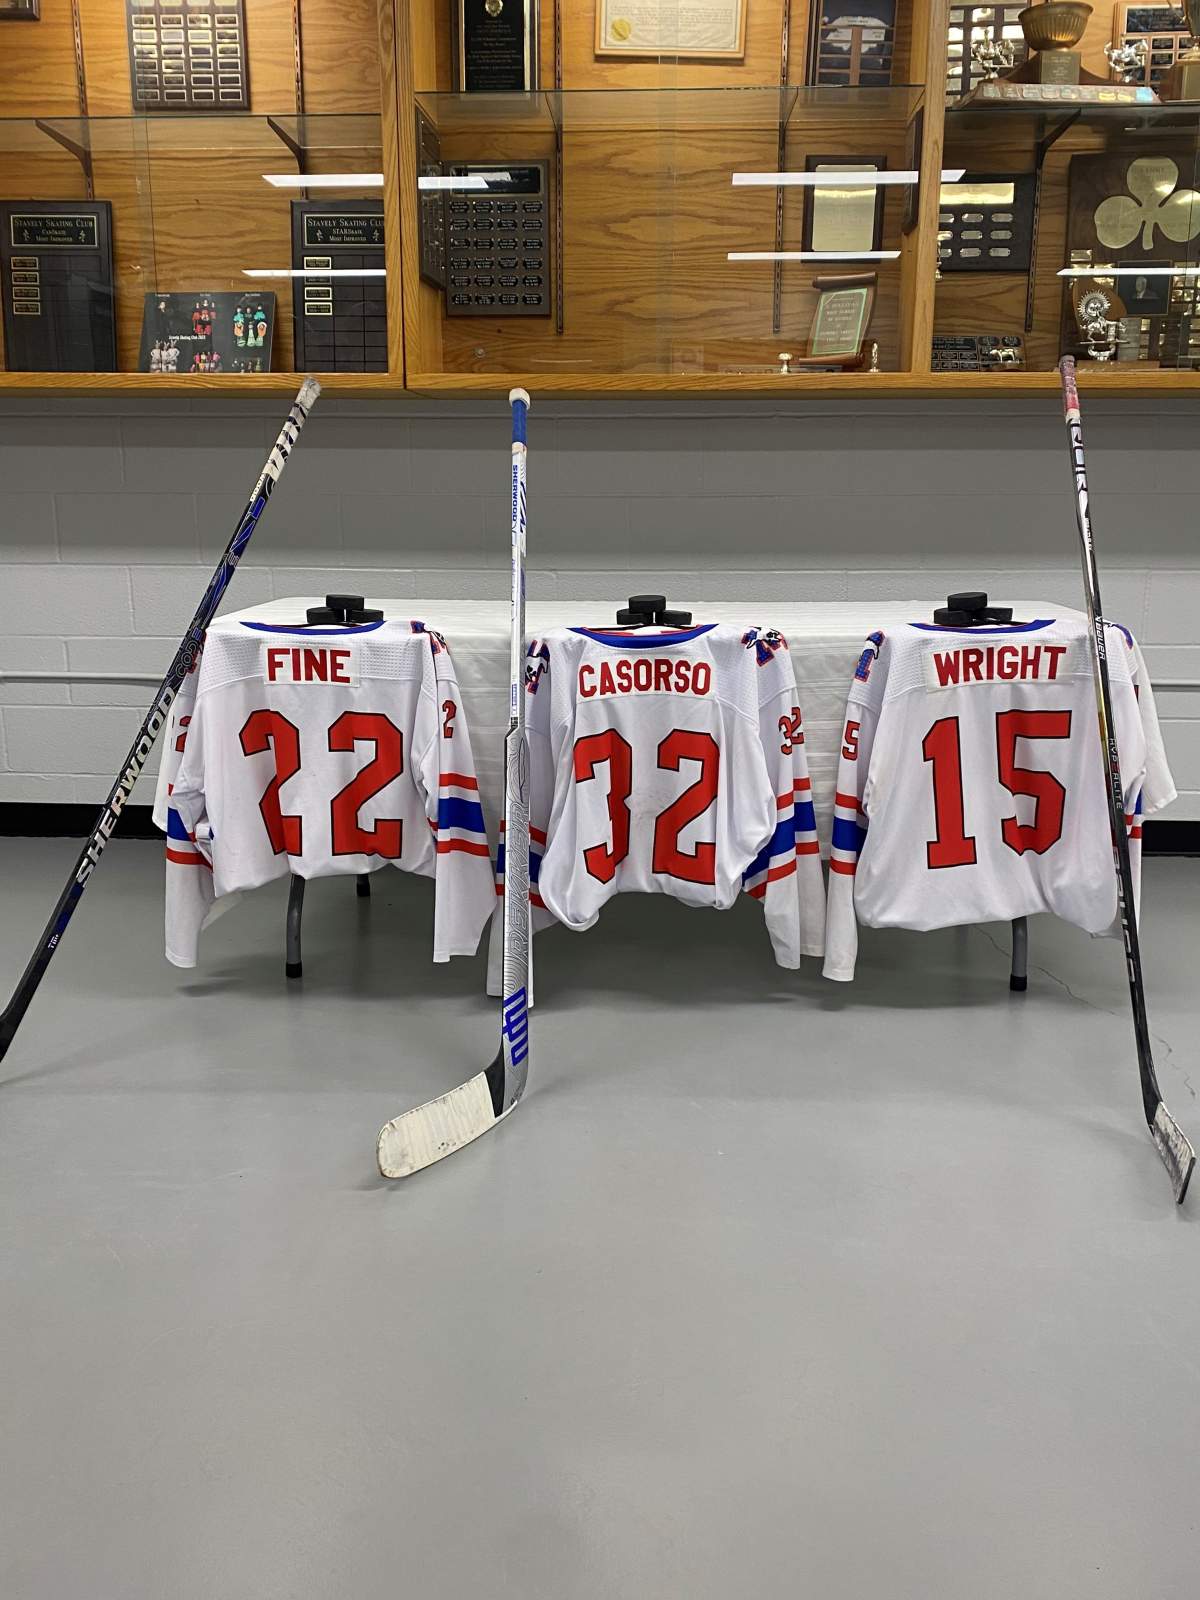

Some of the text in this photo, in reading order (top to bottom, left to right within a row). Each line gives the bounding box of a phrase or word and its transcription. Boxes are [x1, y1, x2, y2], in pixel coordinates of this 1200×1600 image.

[307, 218, 336, 226] STAVELY
[339, 218, 367, 227] SKATING
[266, 647, 351, 684] FINE
[578, 658, 711, 698] CASORSO
[933, 645, 1067, 687] WRIGHT
[75, 686, 177, 888] SHERWOOD
[239, 709, 404, 859] 22
[572, 727, 720, 886] 32
[922, 709, 1072, 869] 15
[1108, 737, 1123, 809] HYPERLITE
